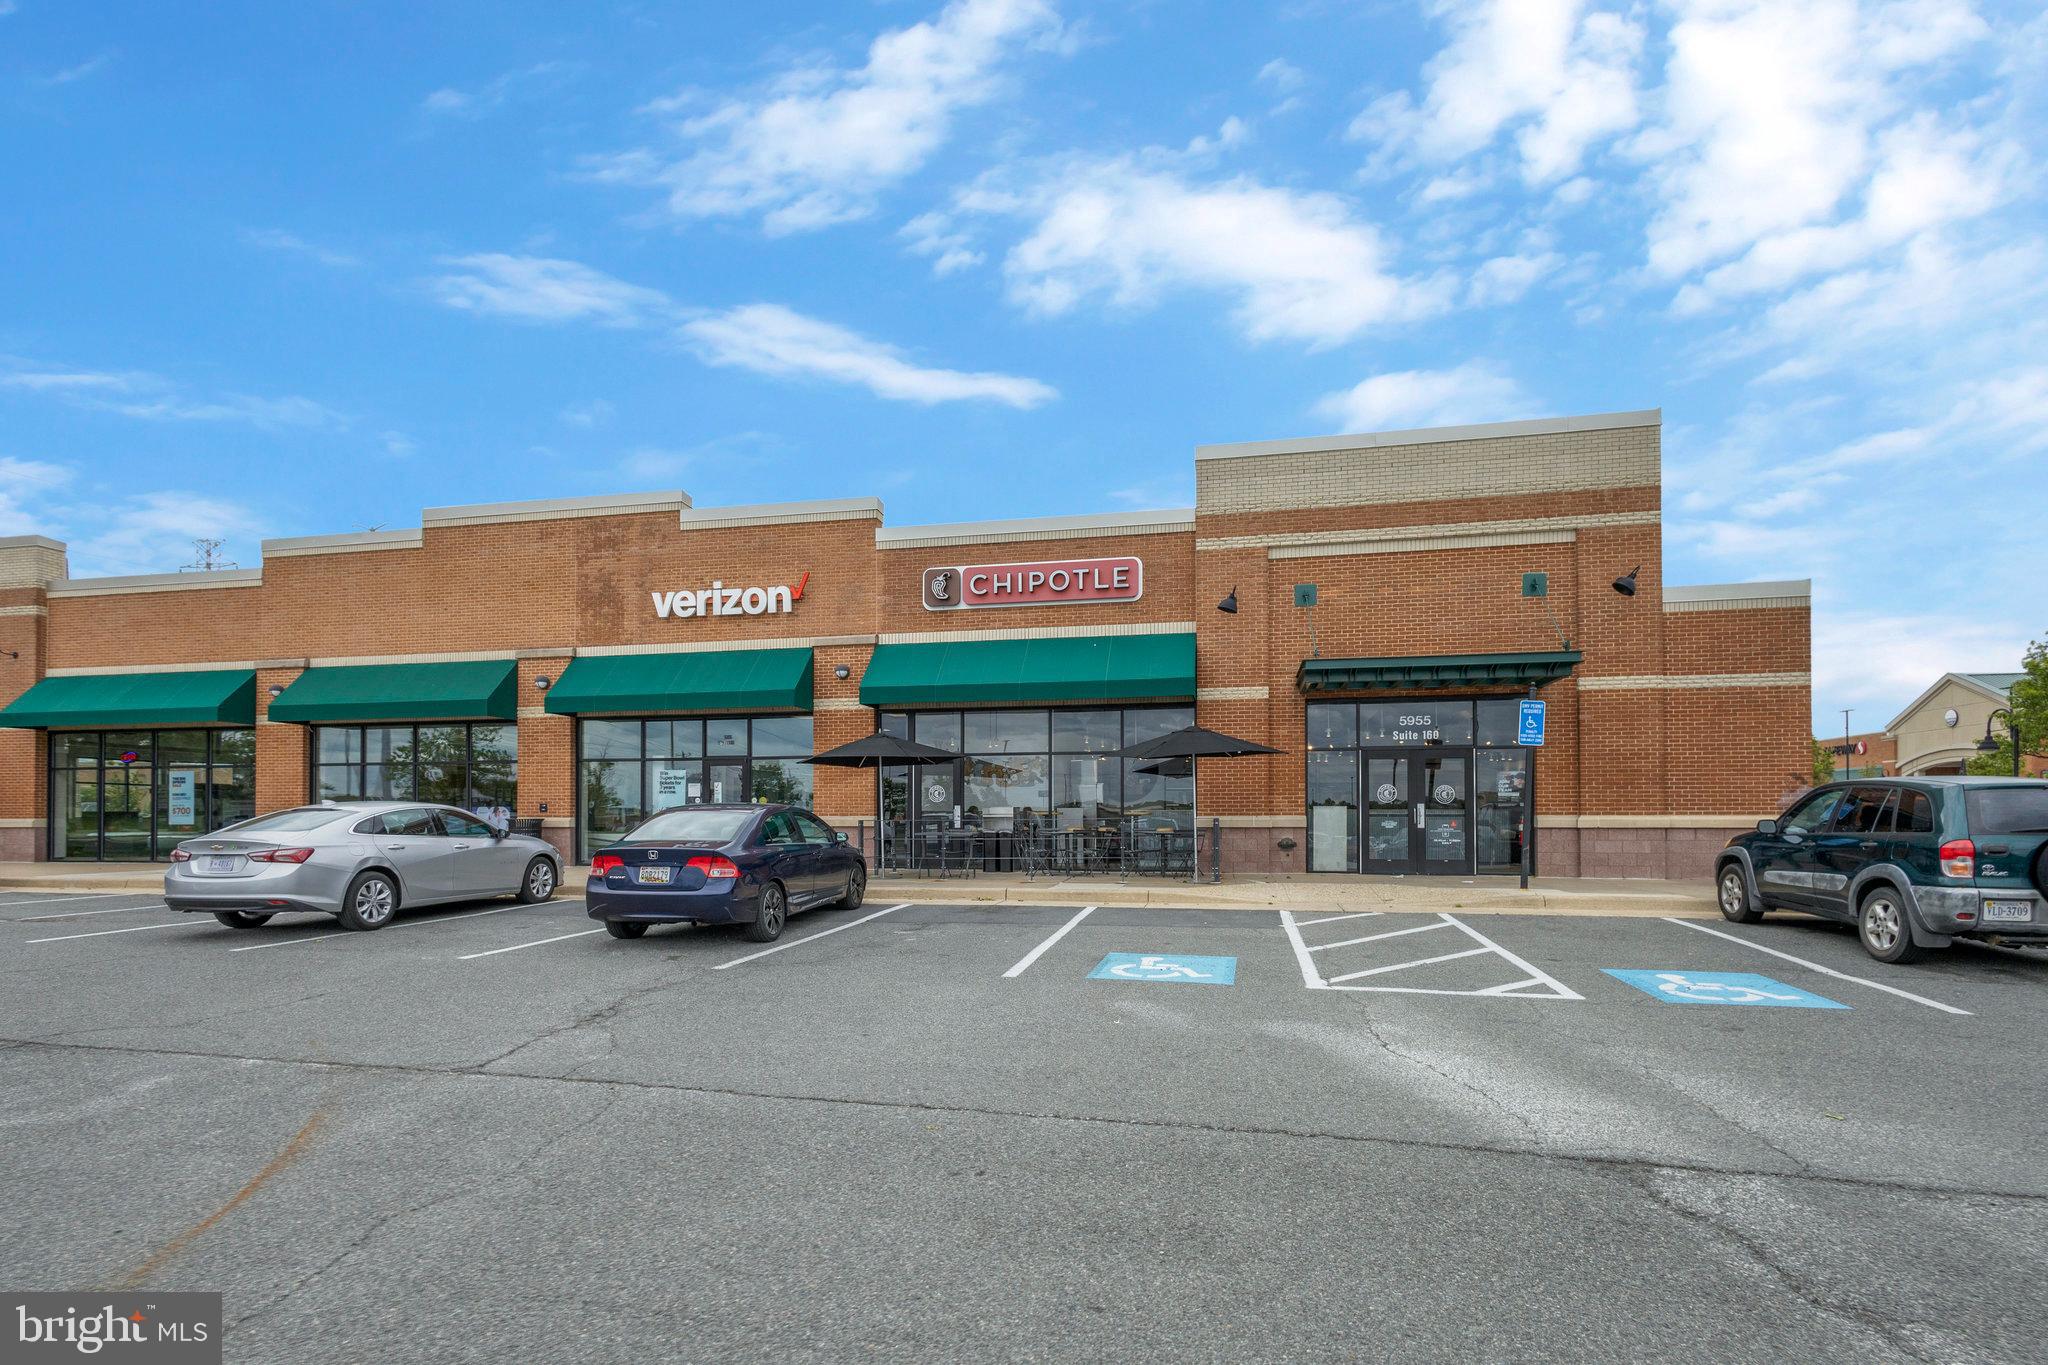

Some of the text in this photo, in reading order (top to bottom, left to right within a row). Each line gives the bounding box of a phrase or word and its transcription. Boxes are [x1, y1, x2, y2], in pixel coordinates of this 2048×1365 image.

[969, 566, 1130, 596] CHIPOTLE
[651, 579, 793, 618] verizon
[1399, 715, 1431, 726] 5955
[1392, 730, 1440, 740] Suite 160
[172, 807, 191, 815] $700
